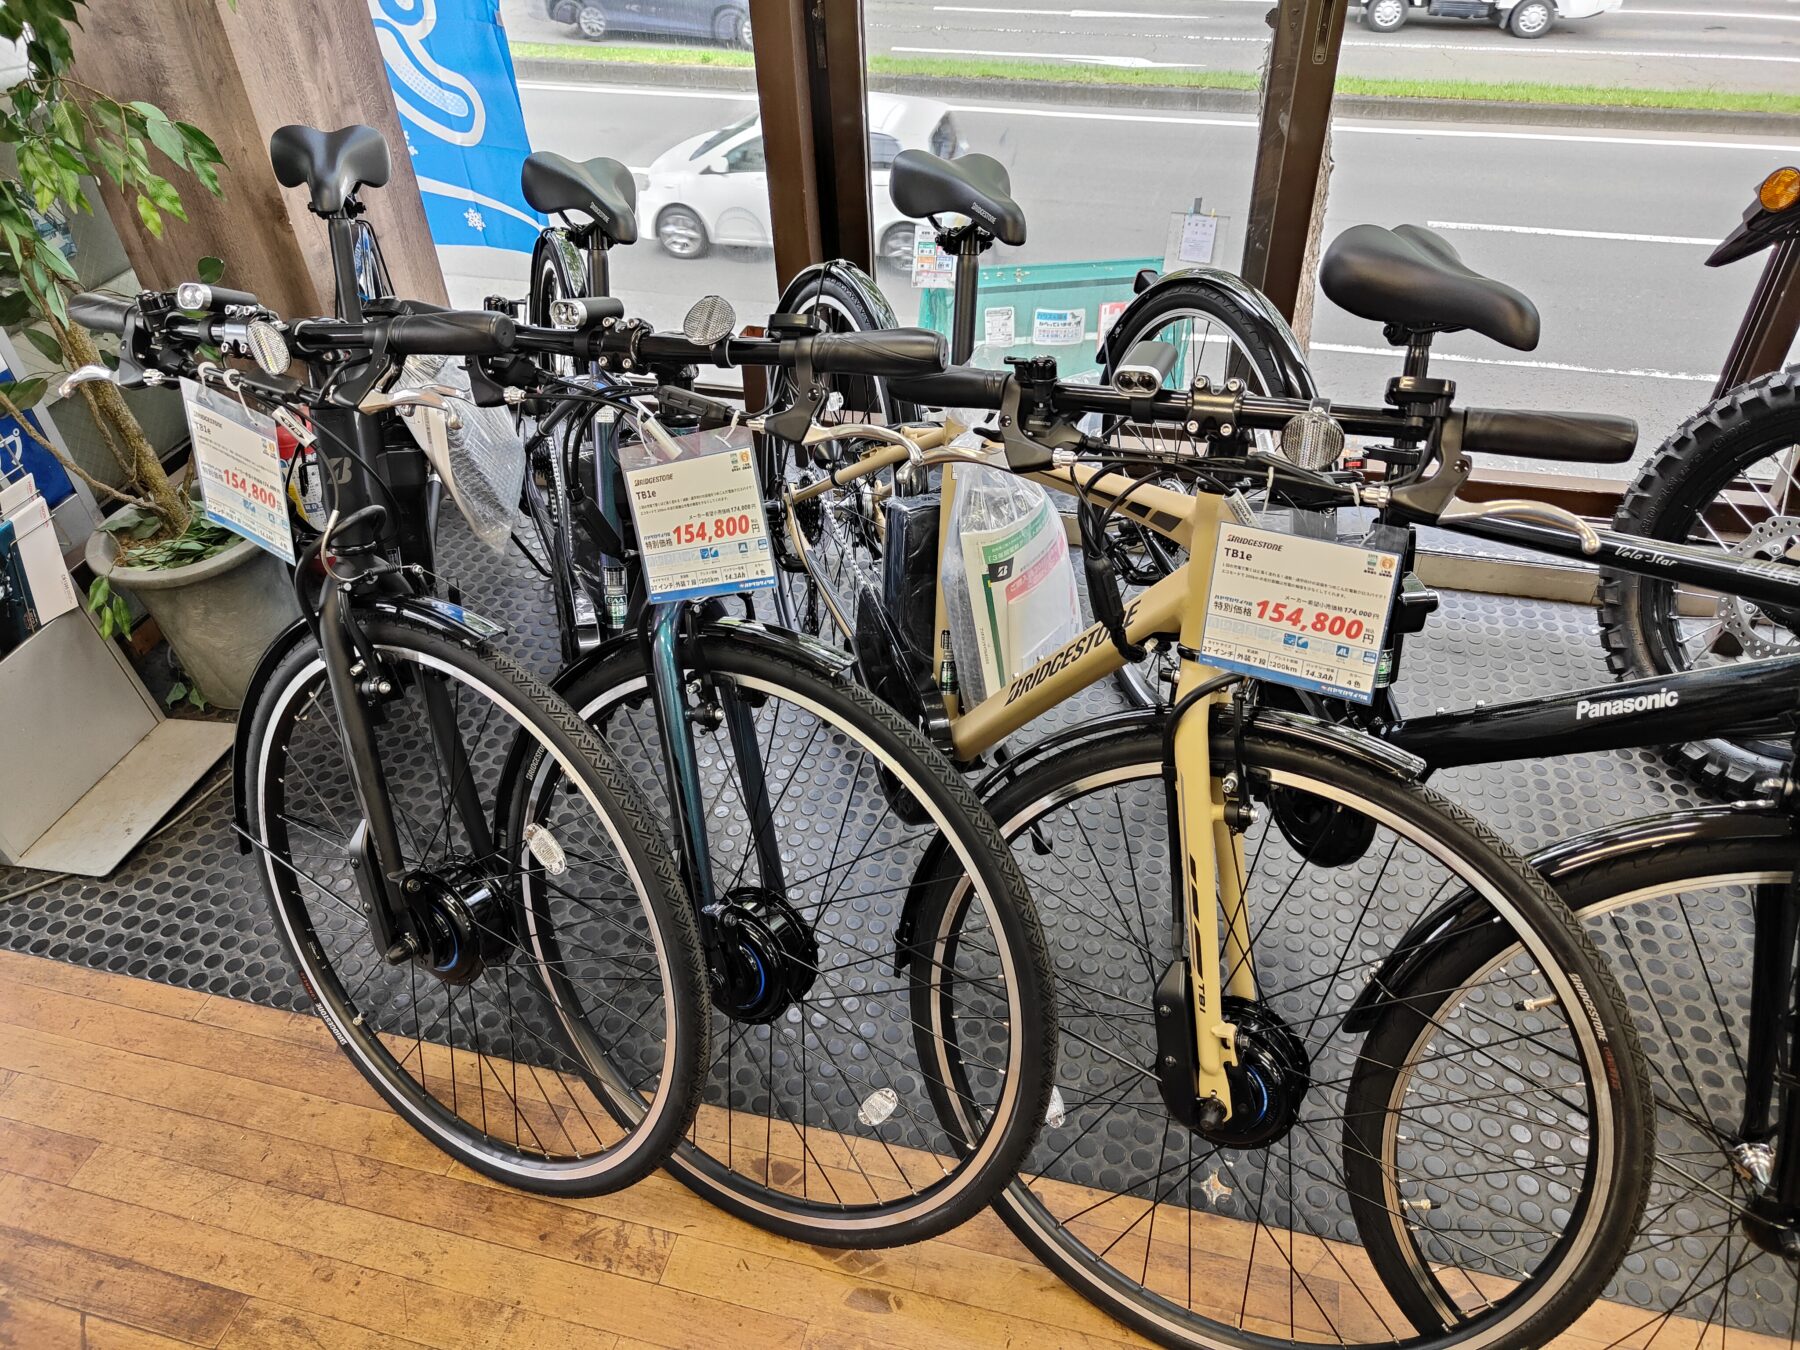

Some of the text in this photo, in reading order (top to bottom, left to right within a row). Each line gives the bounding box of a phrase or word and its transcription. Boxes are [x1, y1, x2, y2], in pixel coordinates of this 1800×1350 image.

[224, 469, 276, 508] 154,800
[635, 487, 657, 501] TB1e
[672, 514, 751, 545] 154,800
[1226, 533, 1283, 552] BRIDGESTONE
[1223, 546, 1253, 561] TB1e
[1613, 545, 1679, 568] Velo-Star
[1212, 599, 1375, 645] 特別価格 154,800 円
[1343, 606, 1372, 618] 174,000
[1003, 599, 1143, 707] BRIDGESTOE
[1212, 647, 1234, 658] インチ
[1304, 668, 1333, 682] 14.3Ah
[1576, 687, 1679, 721] Panasonic
[1567, 972, 1609, 1043] BRIDGESTONE
[315, 1002, 348, 1046] BRIDGESTONE
